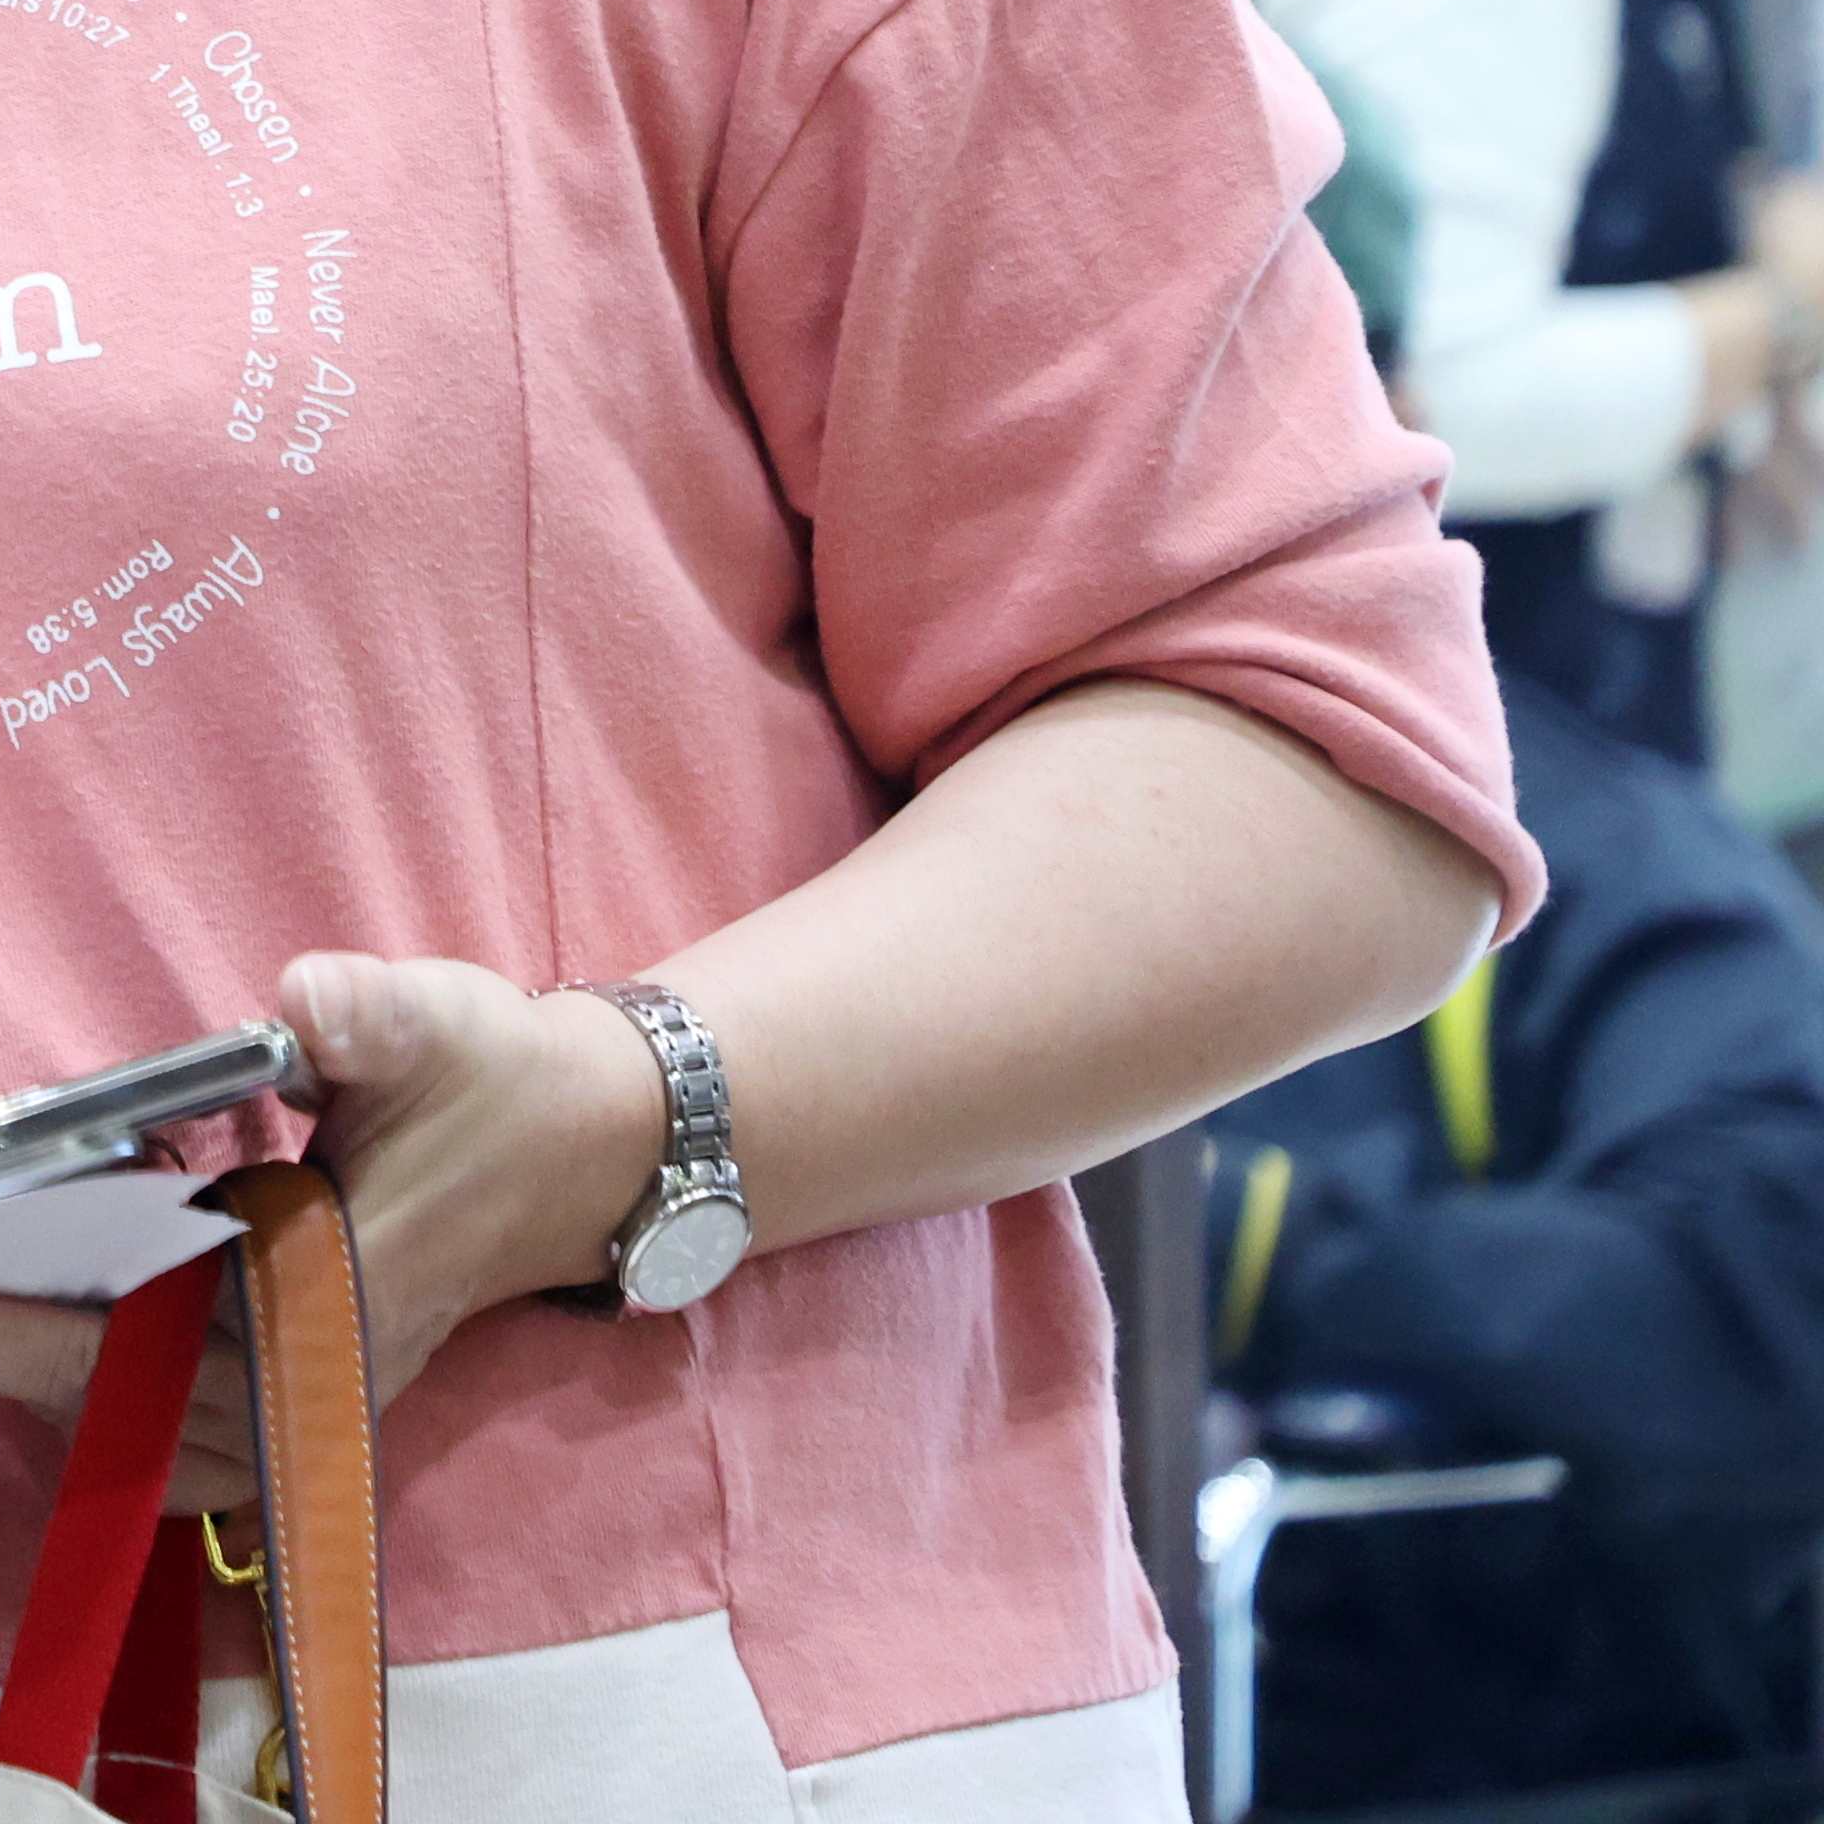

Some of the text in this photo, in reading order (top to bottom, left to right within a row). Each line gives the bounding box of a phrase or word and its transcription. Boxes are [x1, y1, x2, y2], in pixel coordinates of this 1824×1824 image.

[150, 64, 171, 82] 1
[226, 173, 264, 217] 1:3
[204, 30, 299, 163] Chosen
[302, 229, 357, 345] Never
[227, 350, 278, 443] 25:20
[26, 539, 174, 654] Rom. 5:38
[121, 534, 264, 667] Always
